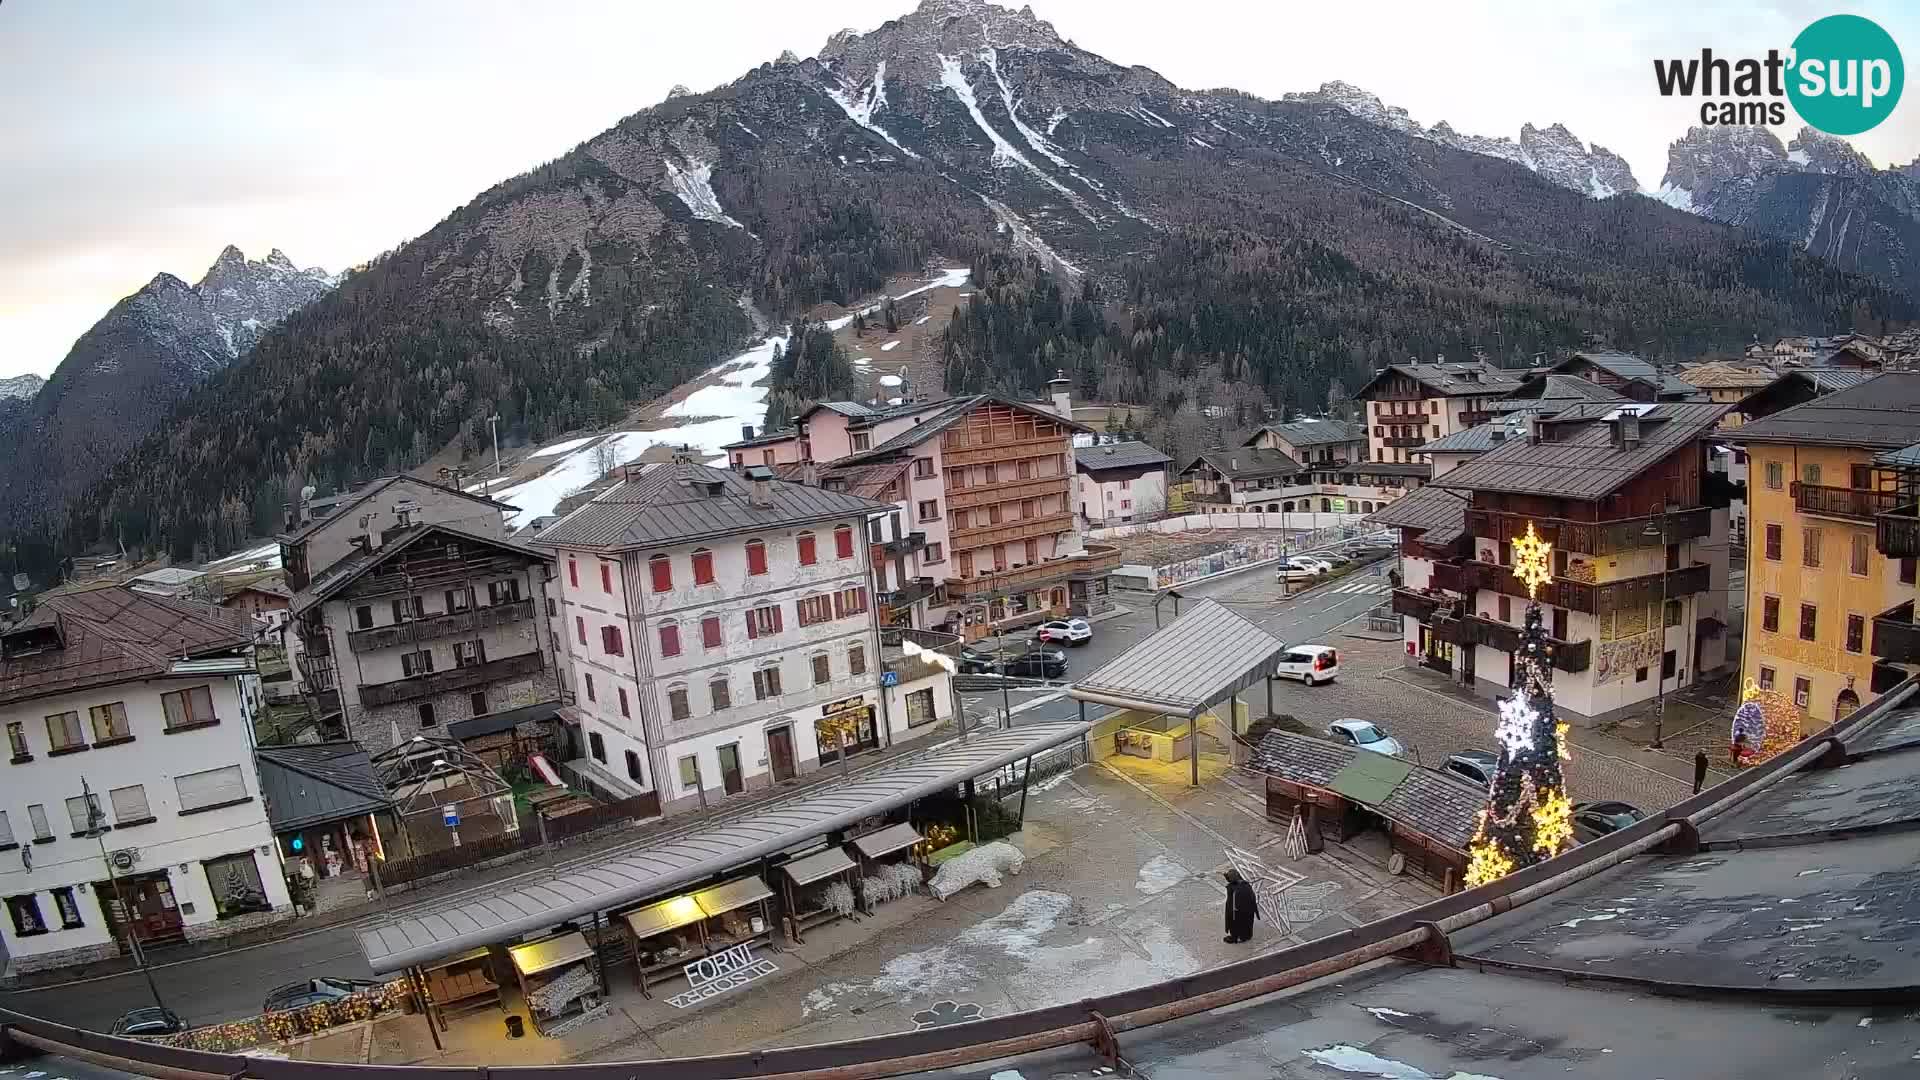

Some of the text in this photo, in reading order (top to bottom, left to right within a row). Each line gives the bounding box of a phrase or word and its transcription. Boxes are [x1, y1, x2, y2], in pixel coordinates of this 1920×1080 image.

[664, 960, 779, 1008] DI SOPRA
[683, 941, 758, 988] FORNI
